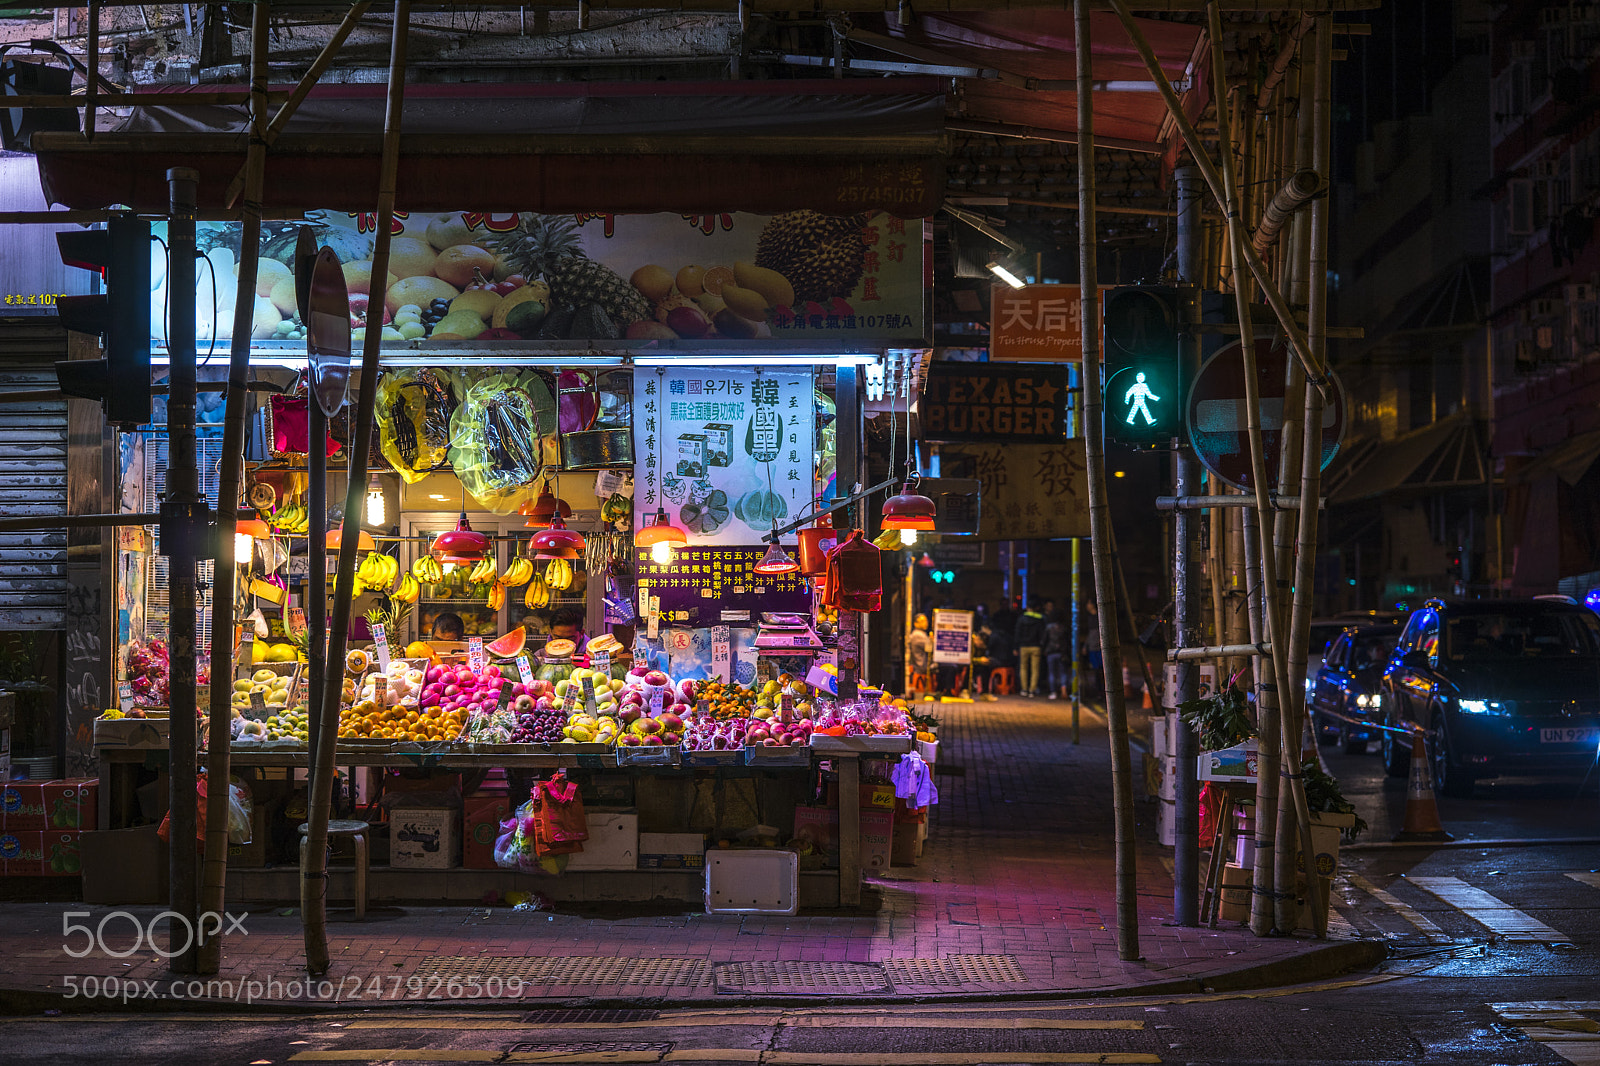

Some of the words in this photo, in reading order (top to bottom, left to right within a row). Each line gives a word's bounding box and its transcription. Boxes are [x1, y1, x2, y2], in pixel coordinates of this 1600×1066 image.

[4, 294, 68, 306] 電氣道107
[776, 314, 913, 330] 北角電氣道107號A
[1045, 335, 1083, 352] Propert
[930, 377, 1033, 404] TEXAS
[670, 401, 745, 421] 黑蒜全面護身功效好
[927, 406, 1055, 434] BURGER
[691, 552, 701, 587] 芒果汁
[1544, 729, 1563, 741] UN
